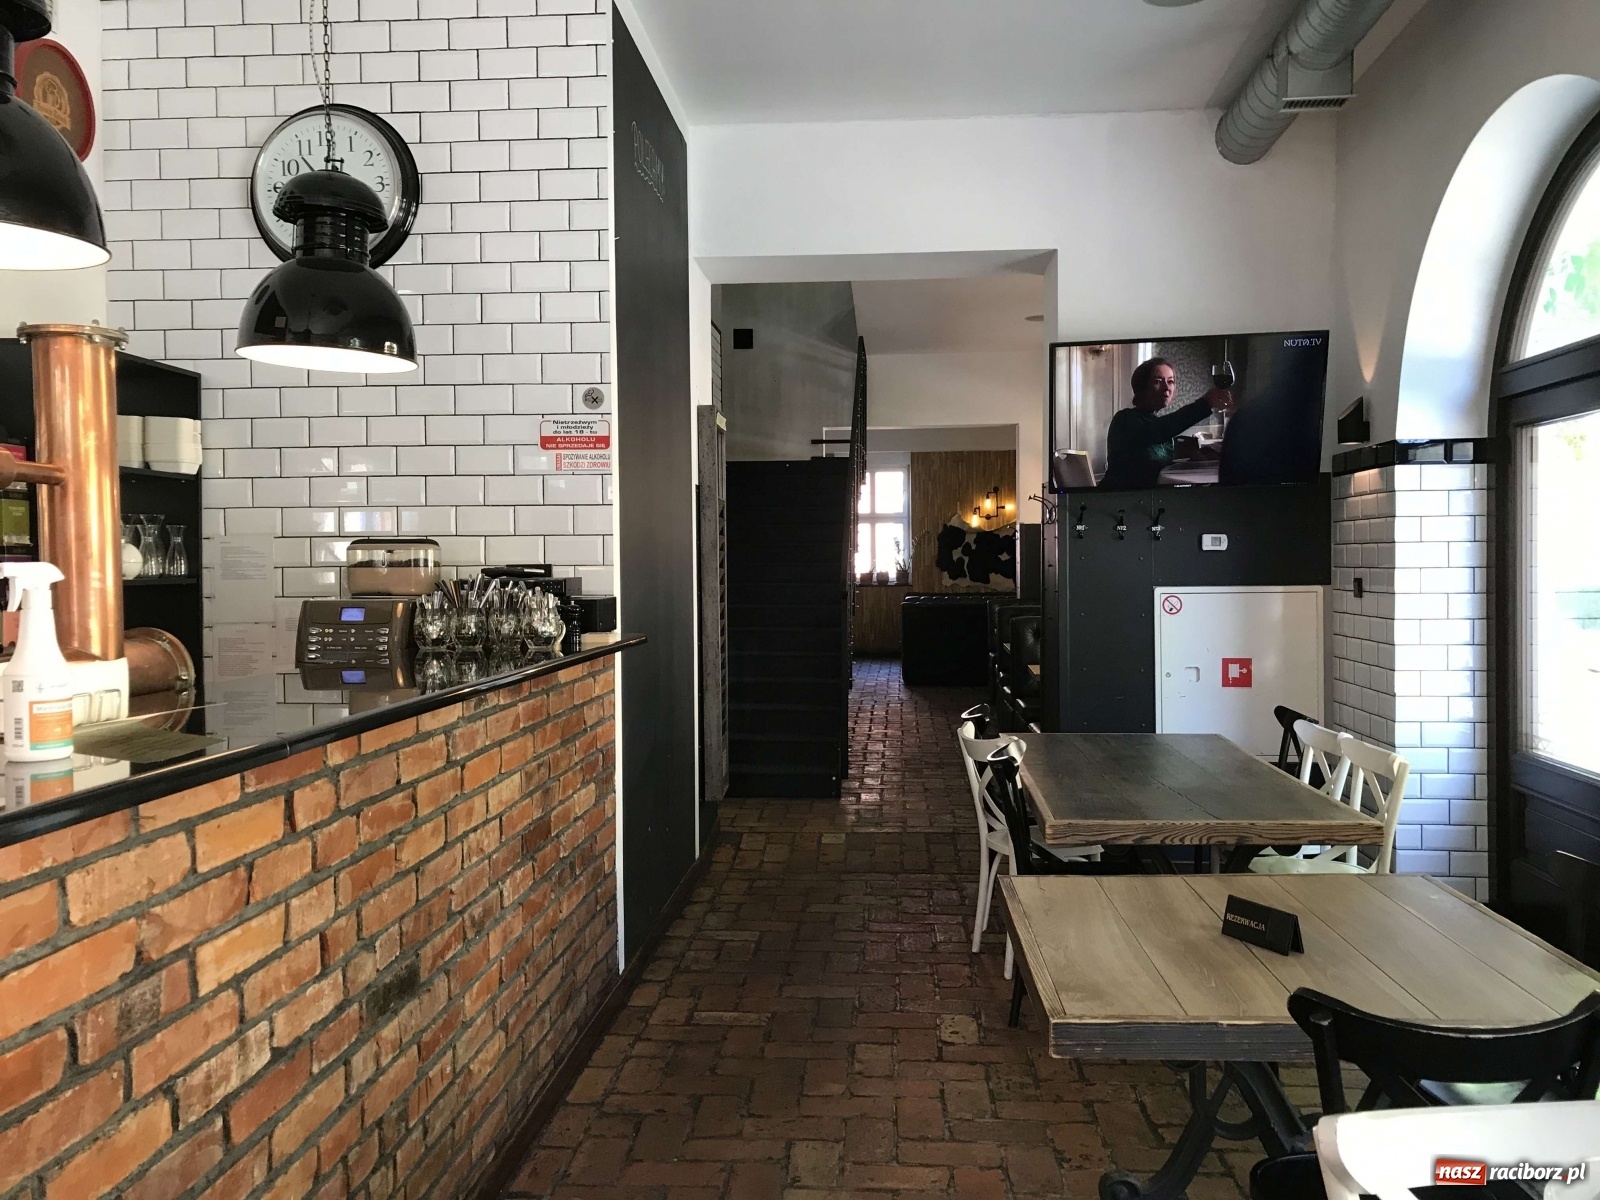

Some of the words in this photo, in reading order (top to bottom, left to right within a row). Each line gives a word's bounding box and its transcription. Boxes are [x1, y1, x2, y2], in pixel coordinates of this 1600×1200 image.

[298, 139, 313, 156] 11
[348, 135, 355, 152] 1
[363, 150, 374, 167] 2
[281, 159, 300, 176] 10
[374, 175, 386, 193] 3
[1226, 912, 1266, 932] REZERWACJA
